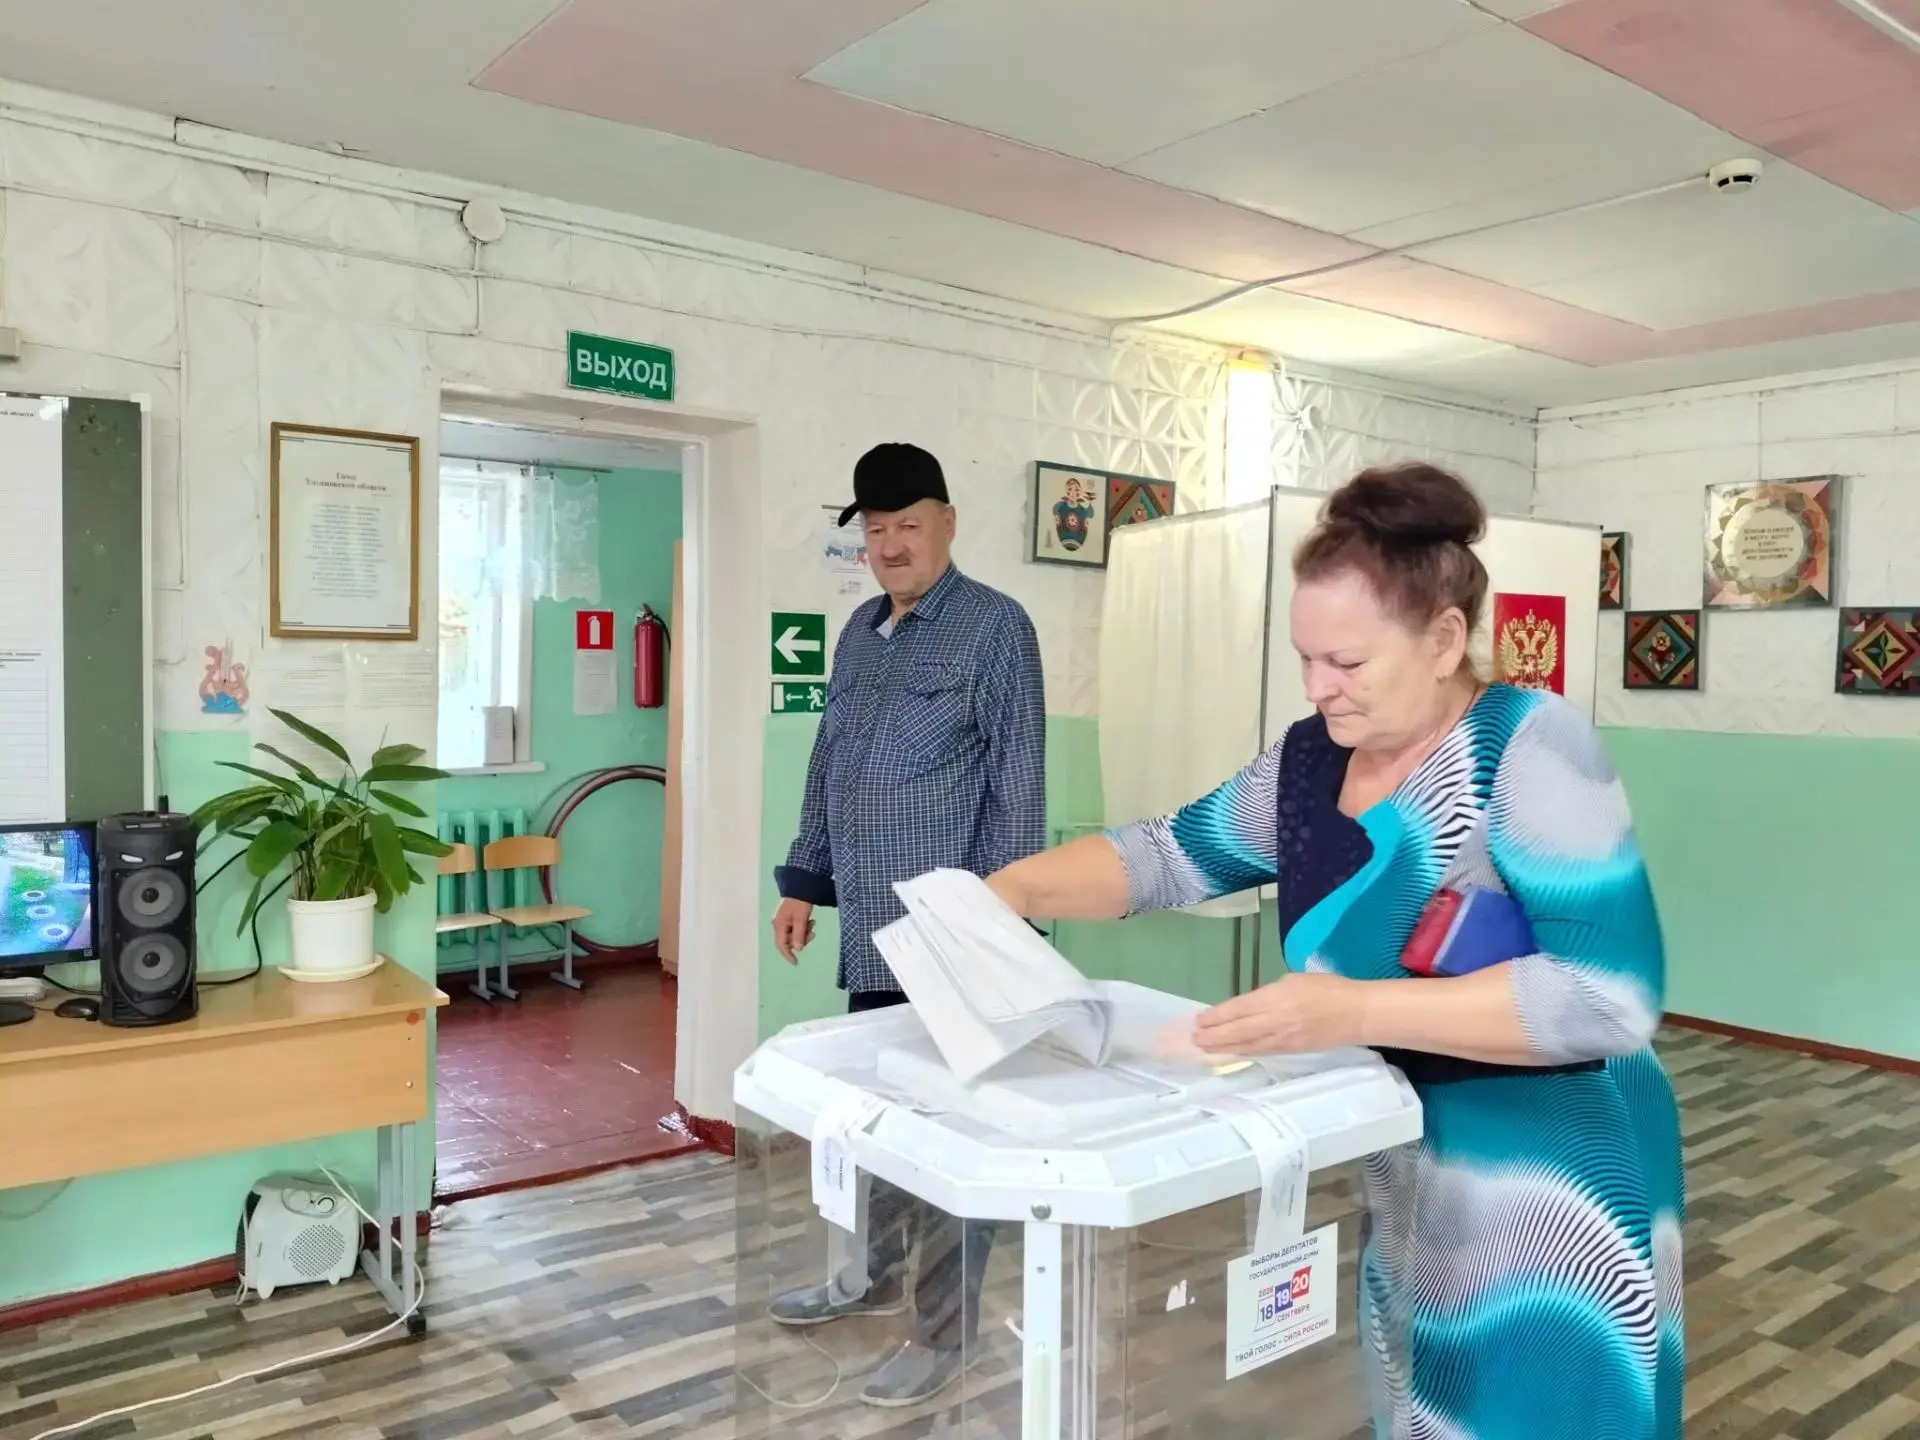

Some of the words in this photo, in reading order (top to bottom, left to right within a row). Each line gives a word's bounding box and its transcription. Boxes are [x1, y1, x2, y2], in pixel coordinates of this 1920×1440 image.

[576, 348, 667, 392] ВЫХОД
[1248, 1255, 1302, 1281] ГОСУДАРСТВЕННОЙ
[1303, 1249, 1319, 1263] ДУМЫ
[1250, 1252, 1280, 1268] ВЫБОРЫ
[1281, 1237, 1318, 1258] ДЕПУТАТОВ
[1260, 1303, 1273, 1322] 18
[1275, 1288, 1290, 1307] 19
[1292, 1274, 1309, 1294] 20
[1277, 1303, 1310, 1322] СЕНТЯБРЯ
[1236, 1347, 1254, 1363] ТВОЙ
[1254, 1339, 1277, 1355] ГОЛОС
[1284, 1329, 1301, 1343] СИЛА
[1302, 1318, 1329, 1335] РОССИИ
